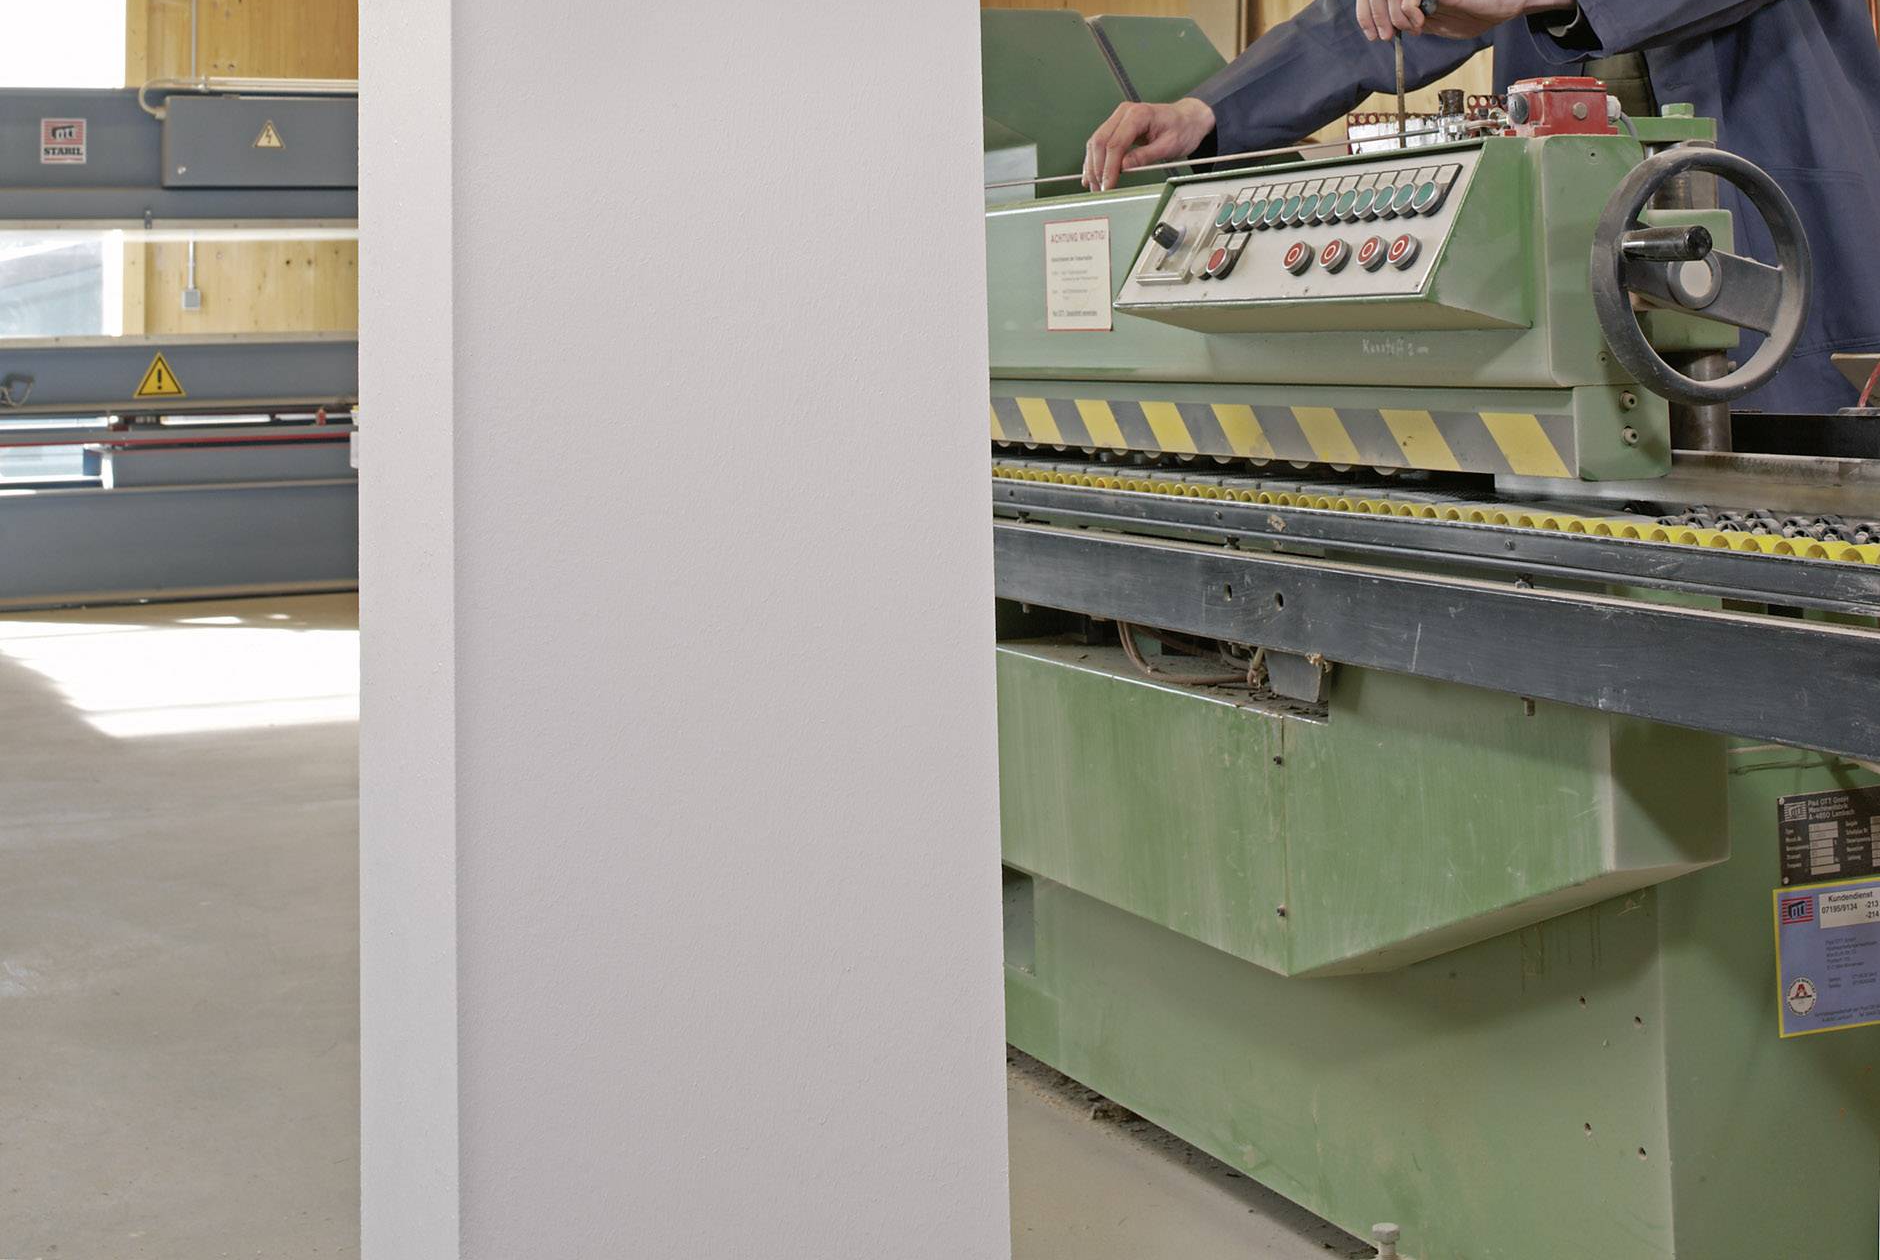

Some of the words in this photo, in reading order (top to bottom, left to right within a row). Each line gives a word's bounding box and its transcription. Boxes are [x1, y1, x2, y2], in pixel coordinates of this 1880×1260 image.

[44, 146, 83, 156] STABIL
[1050, 231, 1078, 243] ACHTUNG
[1828, 891, 1873, 903] Kundendienst
[1821, 903, 1858, 915] 07195/9134
[1864, 899, 1879, 908] -213
